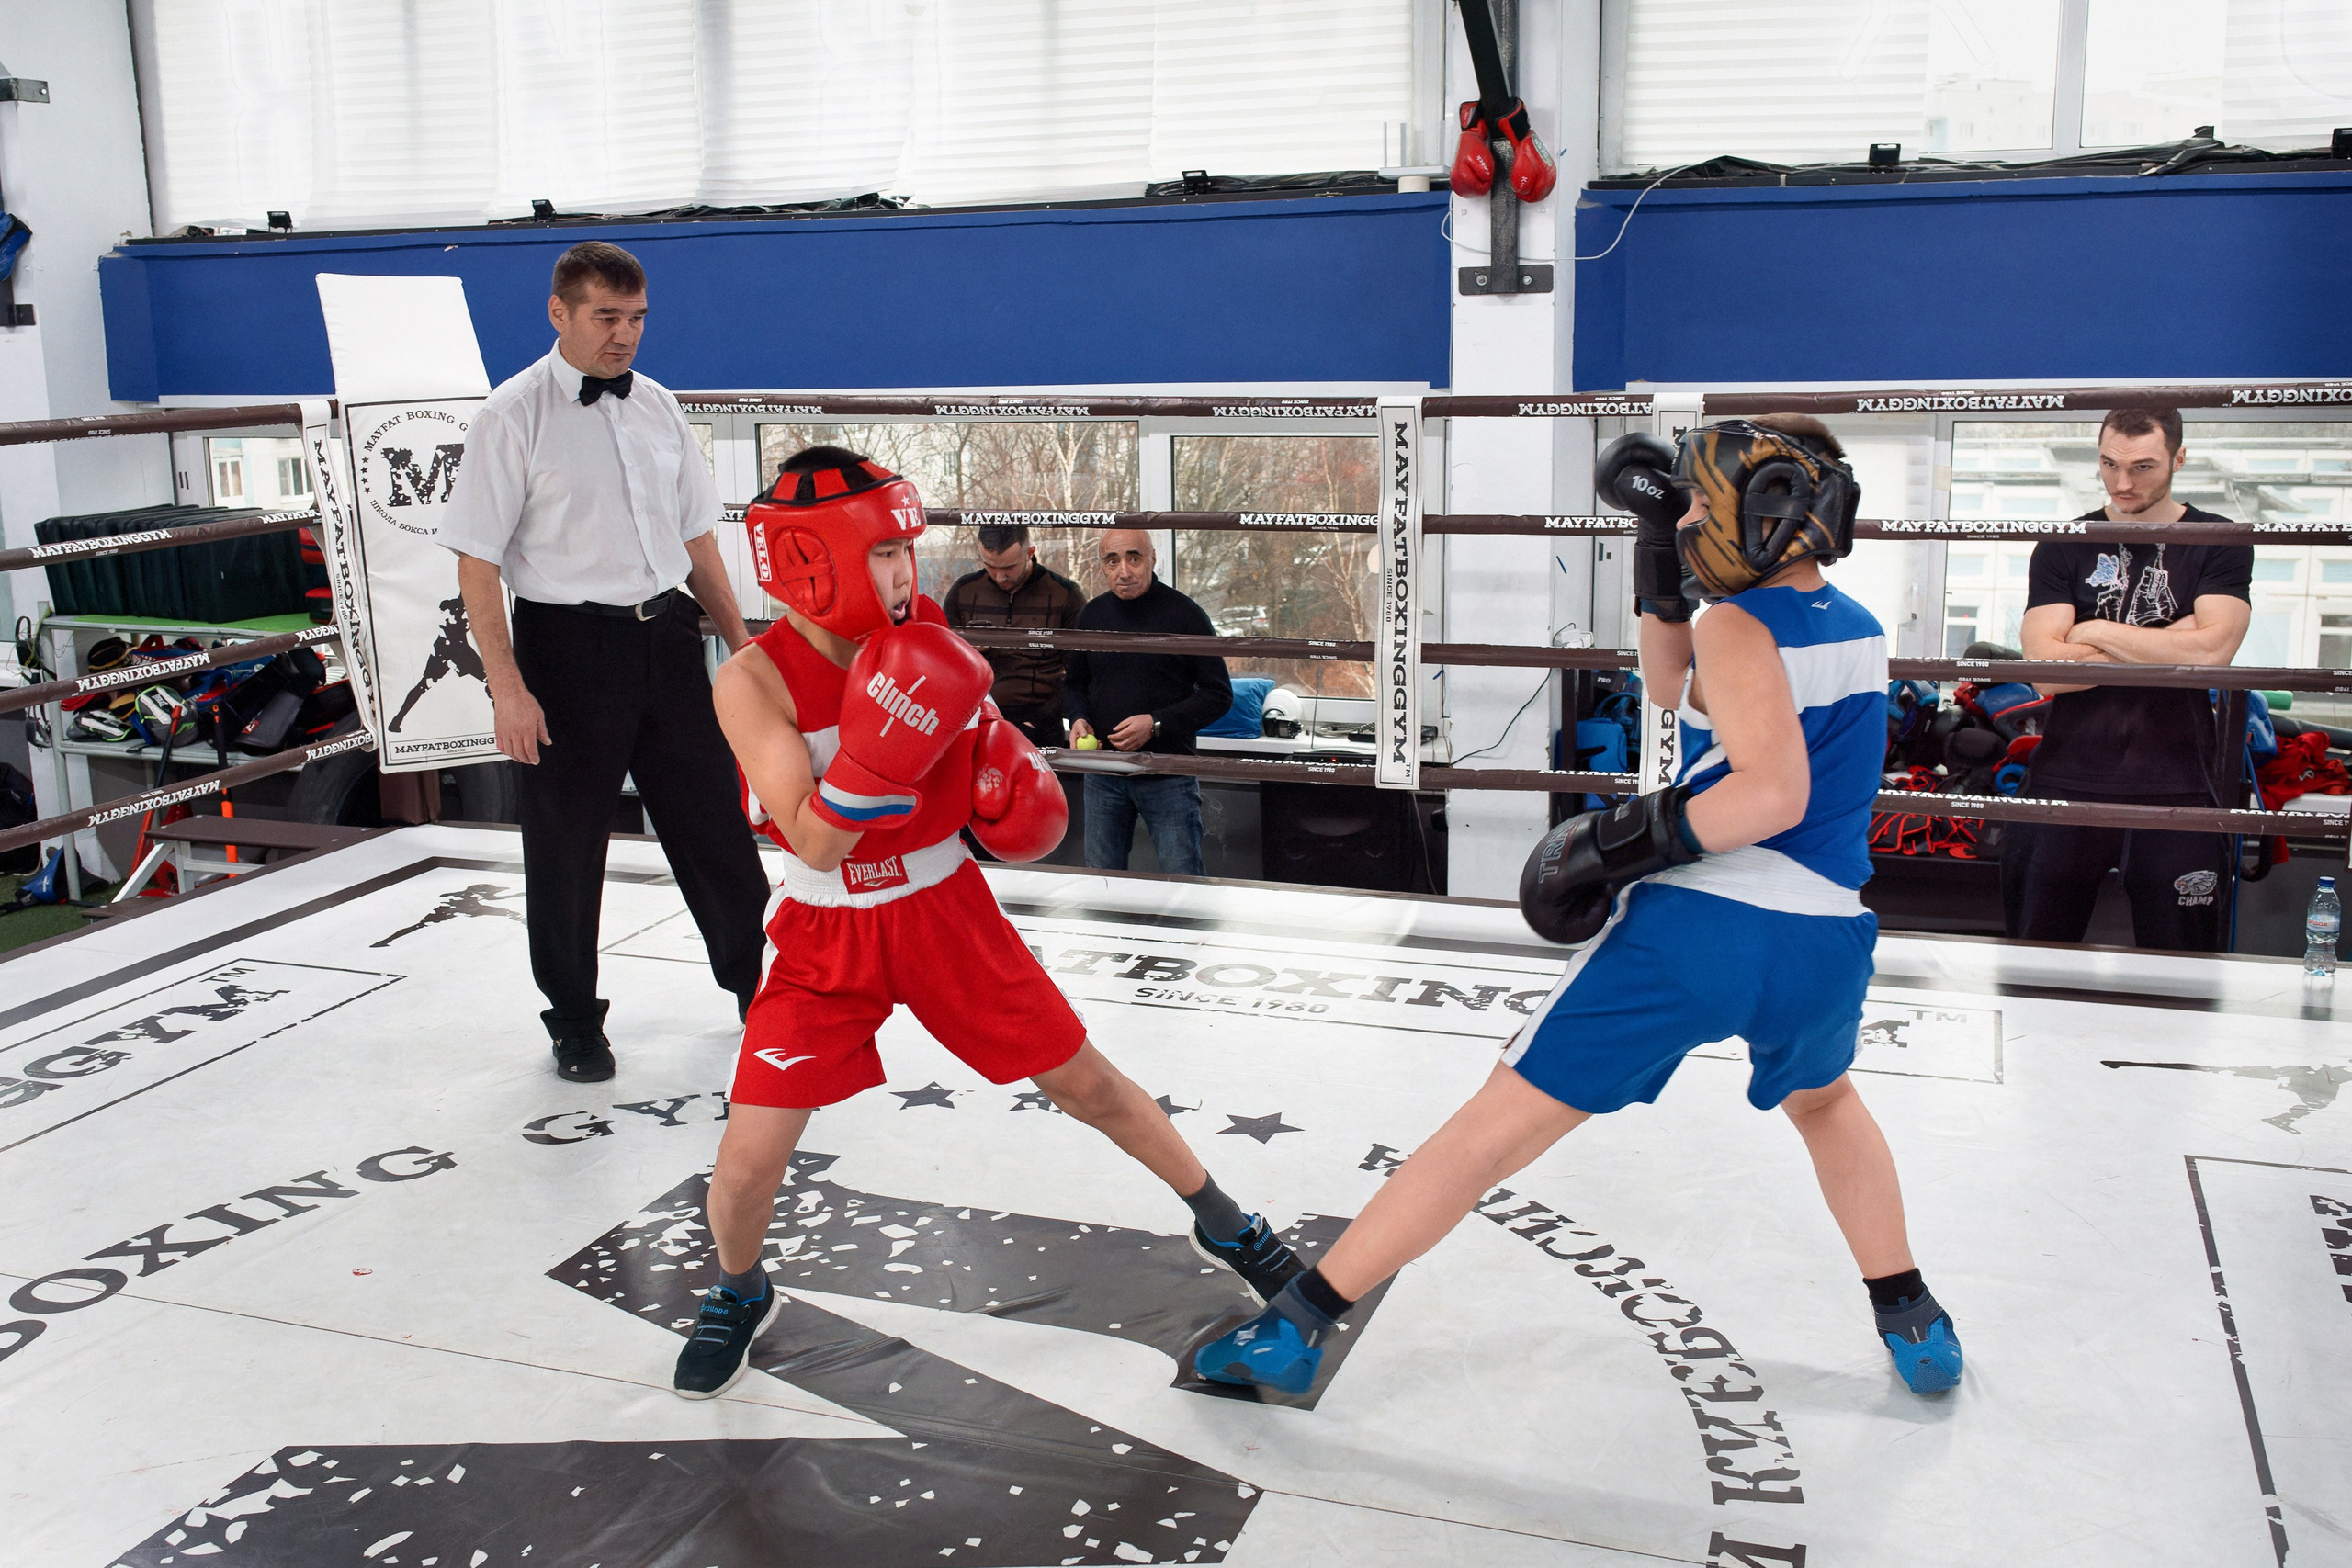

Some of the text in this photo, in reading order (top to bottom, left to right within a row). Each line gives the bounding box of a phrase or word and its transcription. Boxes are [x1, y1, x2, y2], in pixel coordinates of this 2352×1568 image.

[681, 402, 822, 414] MAYFATBOXINGGYM
[934, 404, 1090, 416] MAYFATBOXINGGYM
[1856, 395, 2065, 411] MAYFATBOXINGGYM
[363, 415, 402, 452] MAYFAT
[406, 410, 455, 424] BOXING
[369, 499, 397, 526] ШКОЛА
[398, 523, 428, 535] БОКСА
[960, 513, 1116, 525] MAYFATBOXINGGYM
[1881, 520, 2086, 534] MAYFATBOXINGGYM
[28, 529, 173, 558] MAYFATBOXINGGYM
[754, 521, 772, 581] VELO
[1393, 421, 1409, 764] MAYFATBOXINGGYM
[1385, 600, 1393, 624] 1980
[75, 652, 210, 693] MAYFATBOXINGGYM
[866, 671, 939, 736] clinch
[87, 779, 220, 828] MAYFATBOXINGGYM
[846, 856, 903, 885] EVERLAST
[2177, 896, 2214, 907] CHAMP
[1134, 987, 1331, 1015] SINCE 1980
